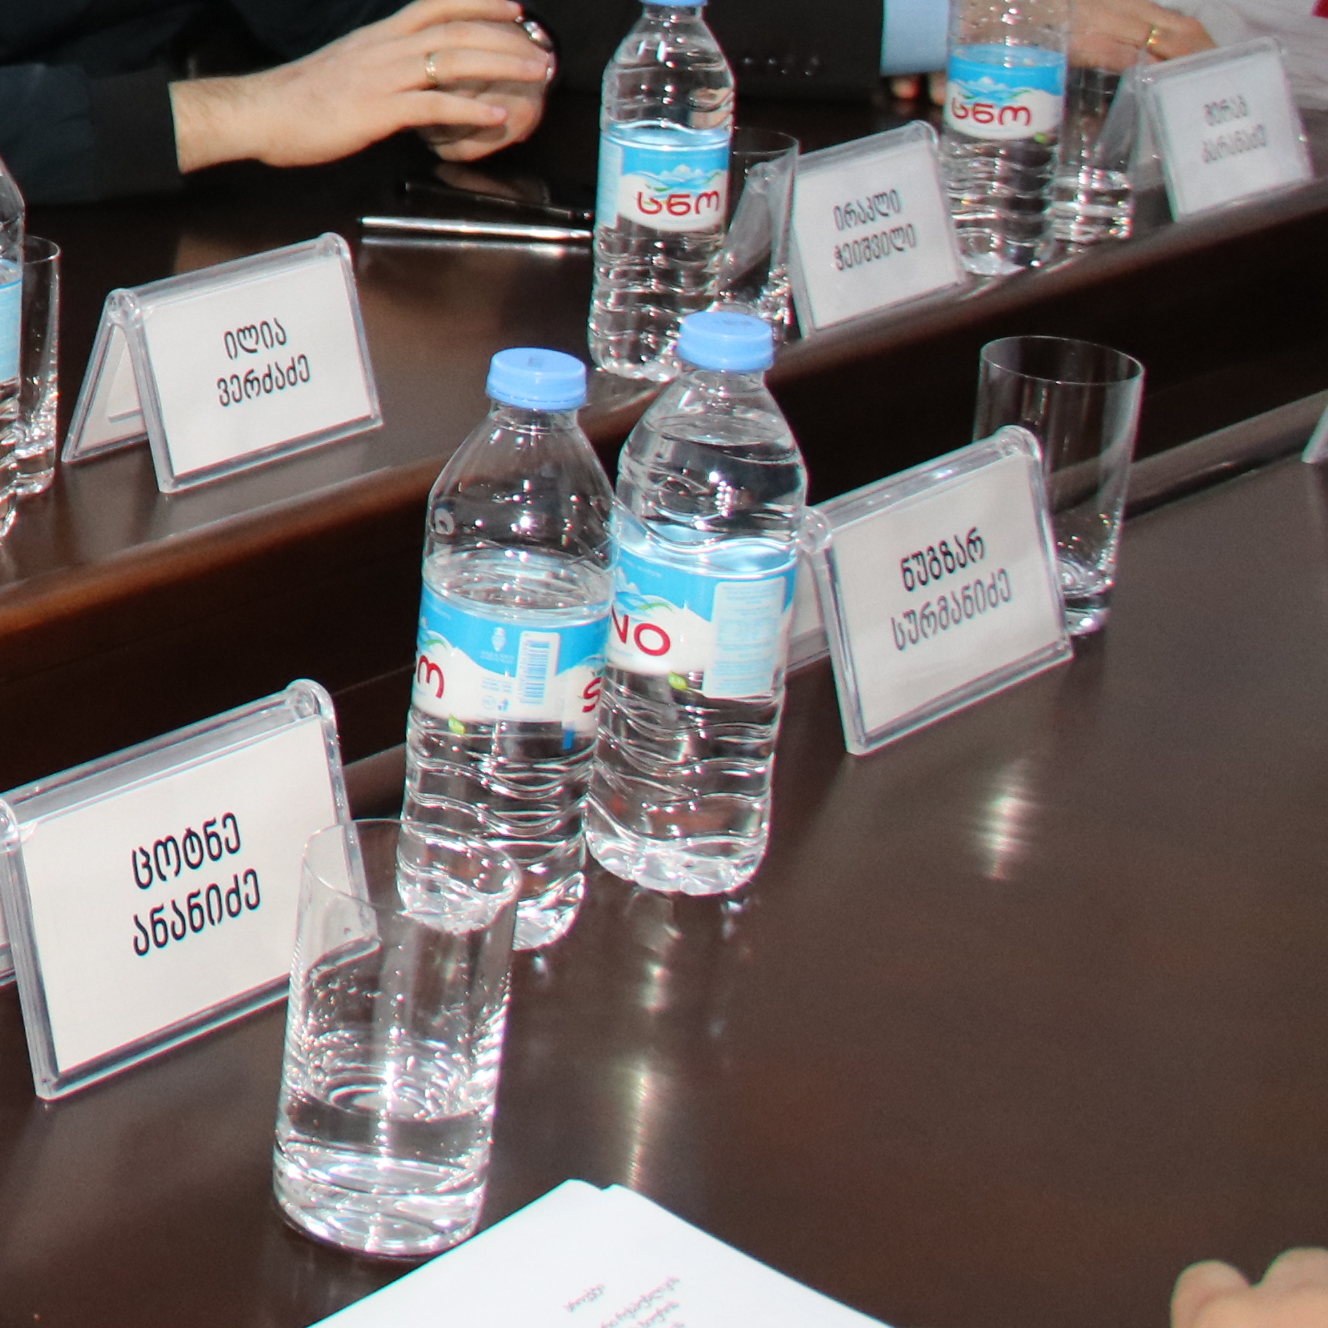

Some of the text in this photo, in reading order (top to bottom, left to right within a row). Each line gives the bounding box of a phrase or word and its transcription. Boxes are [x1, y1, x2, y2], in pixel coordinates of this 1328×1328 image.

[951, 97, 1031, 126] სნო
[637, 190, 720, 216] სნო
[833, 188, 901, 231] ირაკლი
[224, 317, 287, 360] ილია
[217, 354, 311, 407] ვერძაძე
[900, 526, 985, 592] ნუგზარ
[611, 605, 672, 657] NO
[890, 568, 1011, 651] სურმანიძე
[131, 811, 241, 890] ცოტნე
[132, 868, 260, 956] ანანიძე
